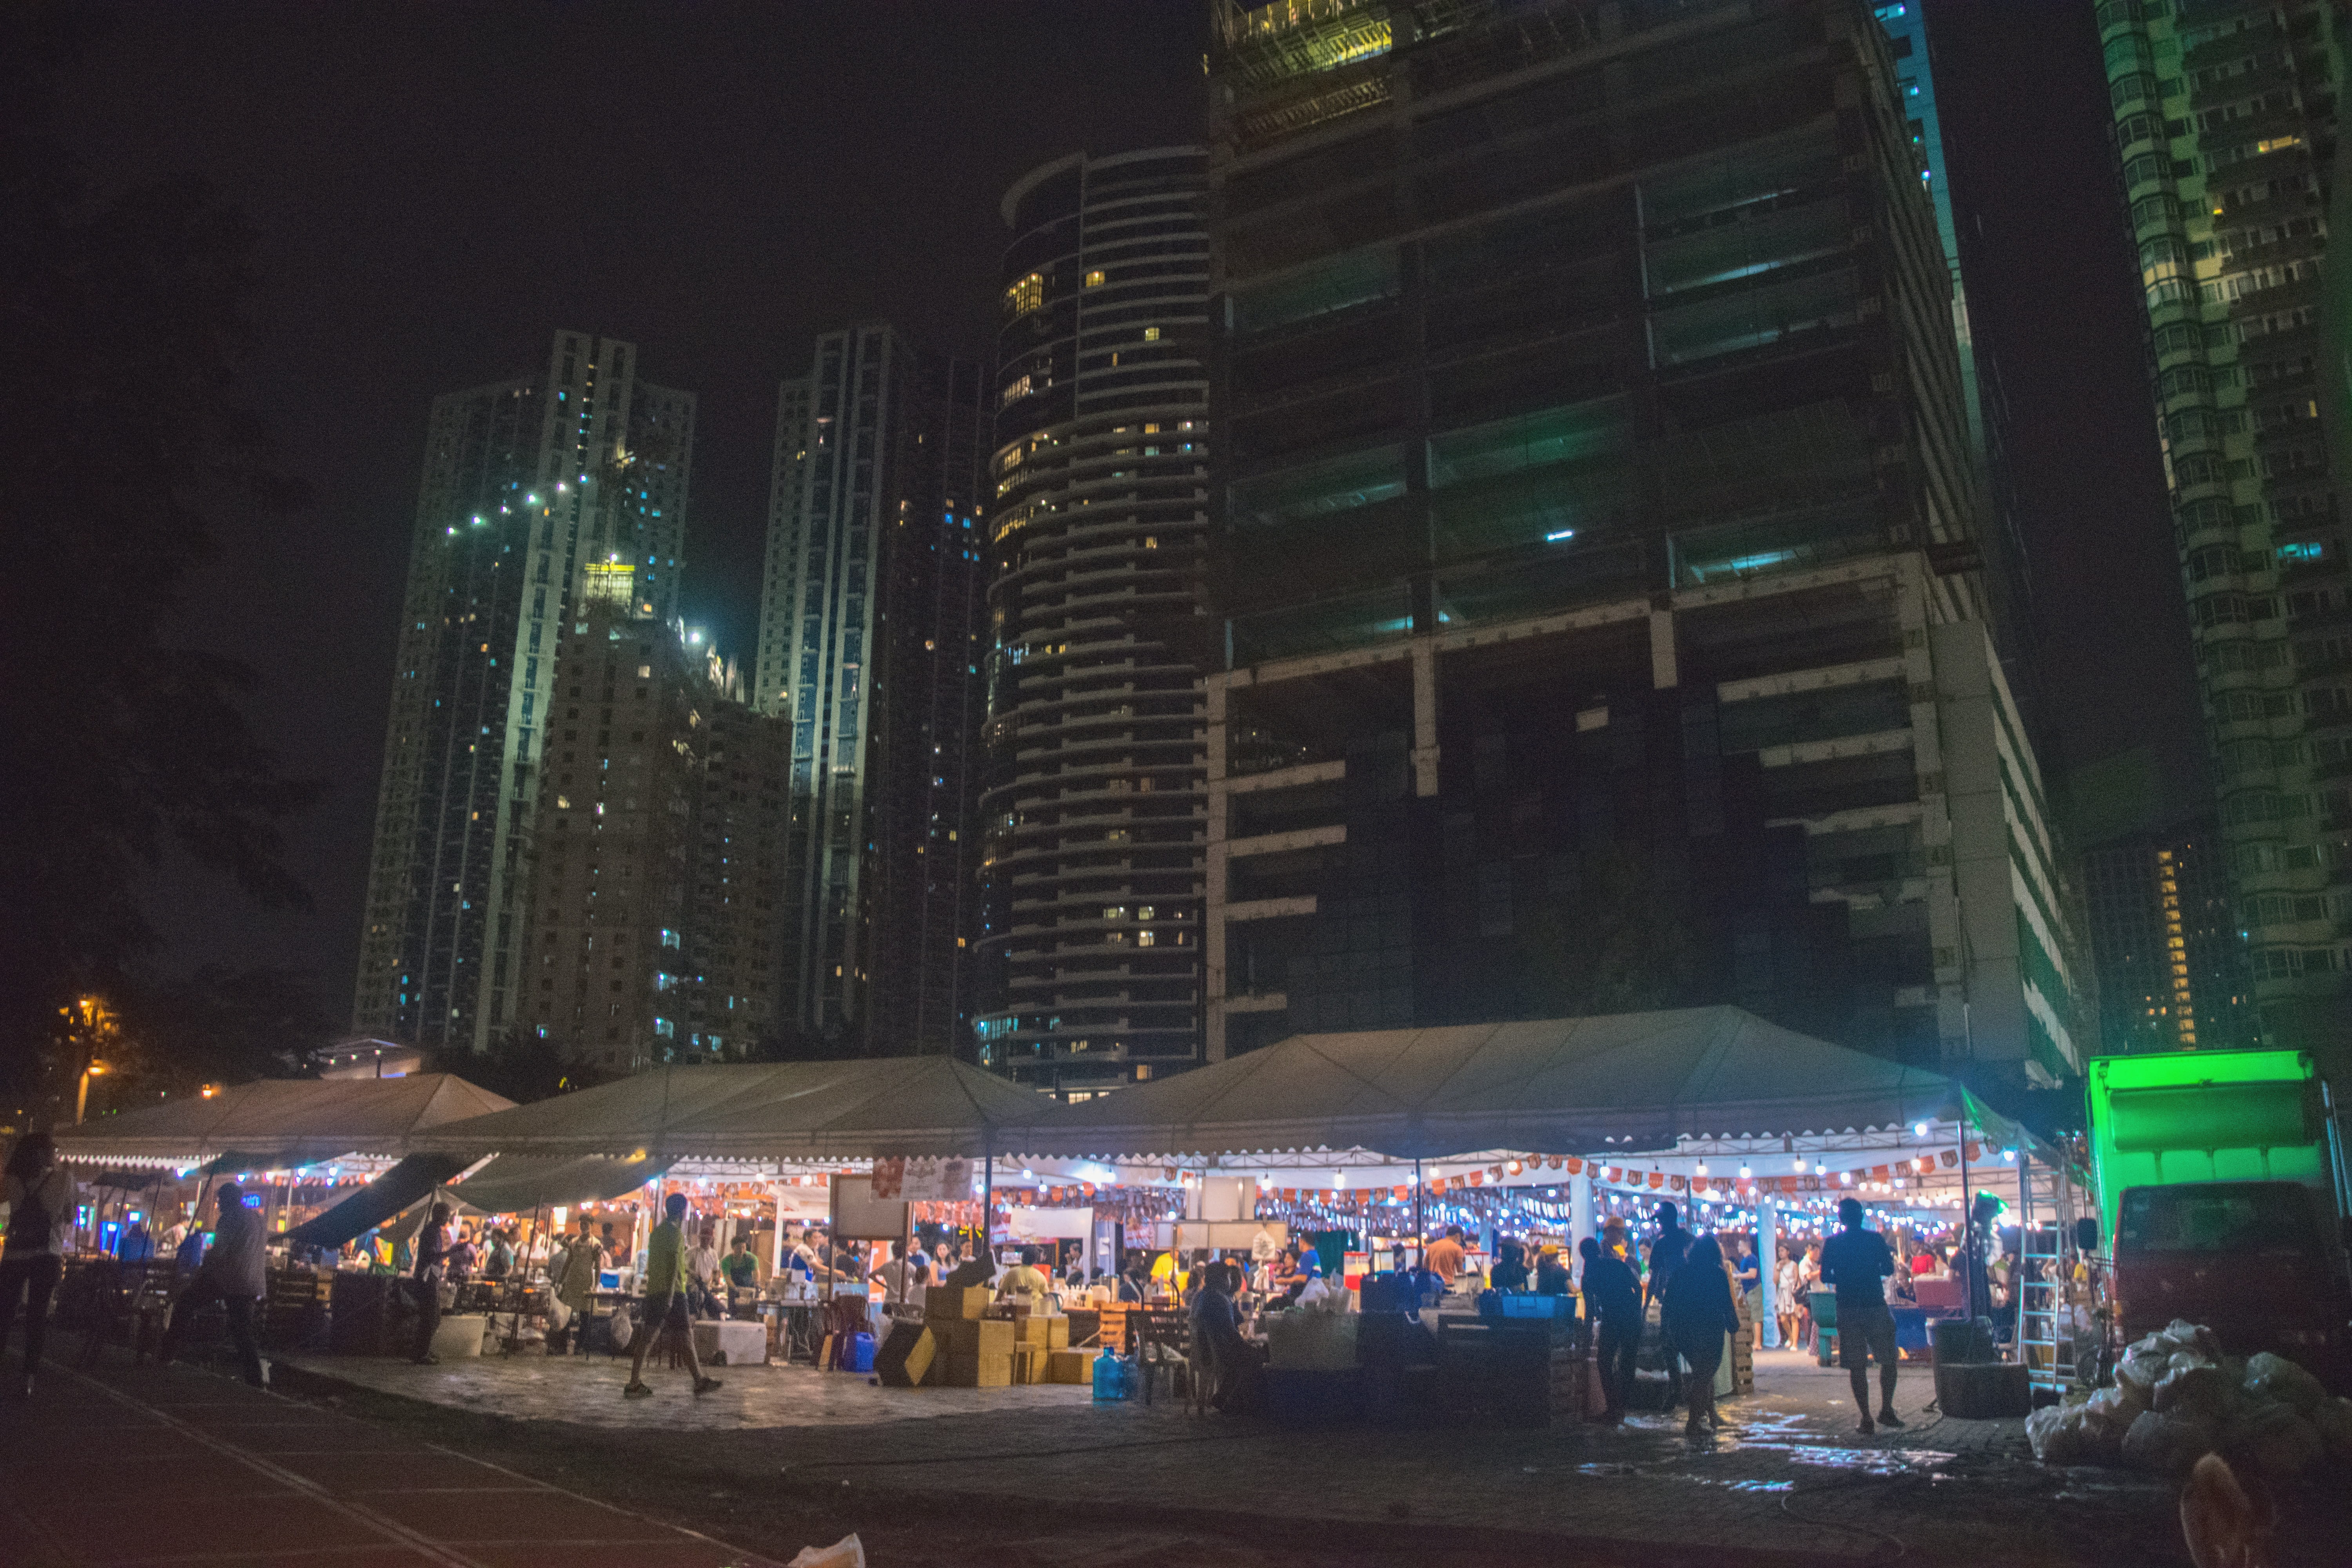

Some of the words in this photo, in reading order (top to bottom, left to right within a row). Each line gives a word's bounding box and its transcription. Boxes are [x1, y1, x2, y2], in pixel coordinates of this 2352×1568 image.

[1908, 630, 1916, 645] 7
[1925, 777, 1933, 791] 5
[1931, 848, 1940, 863] 4
[1940, 949, 1947, 965] 3
